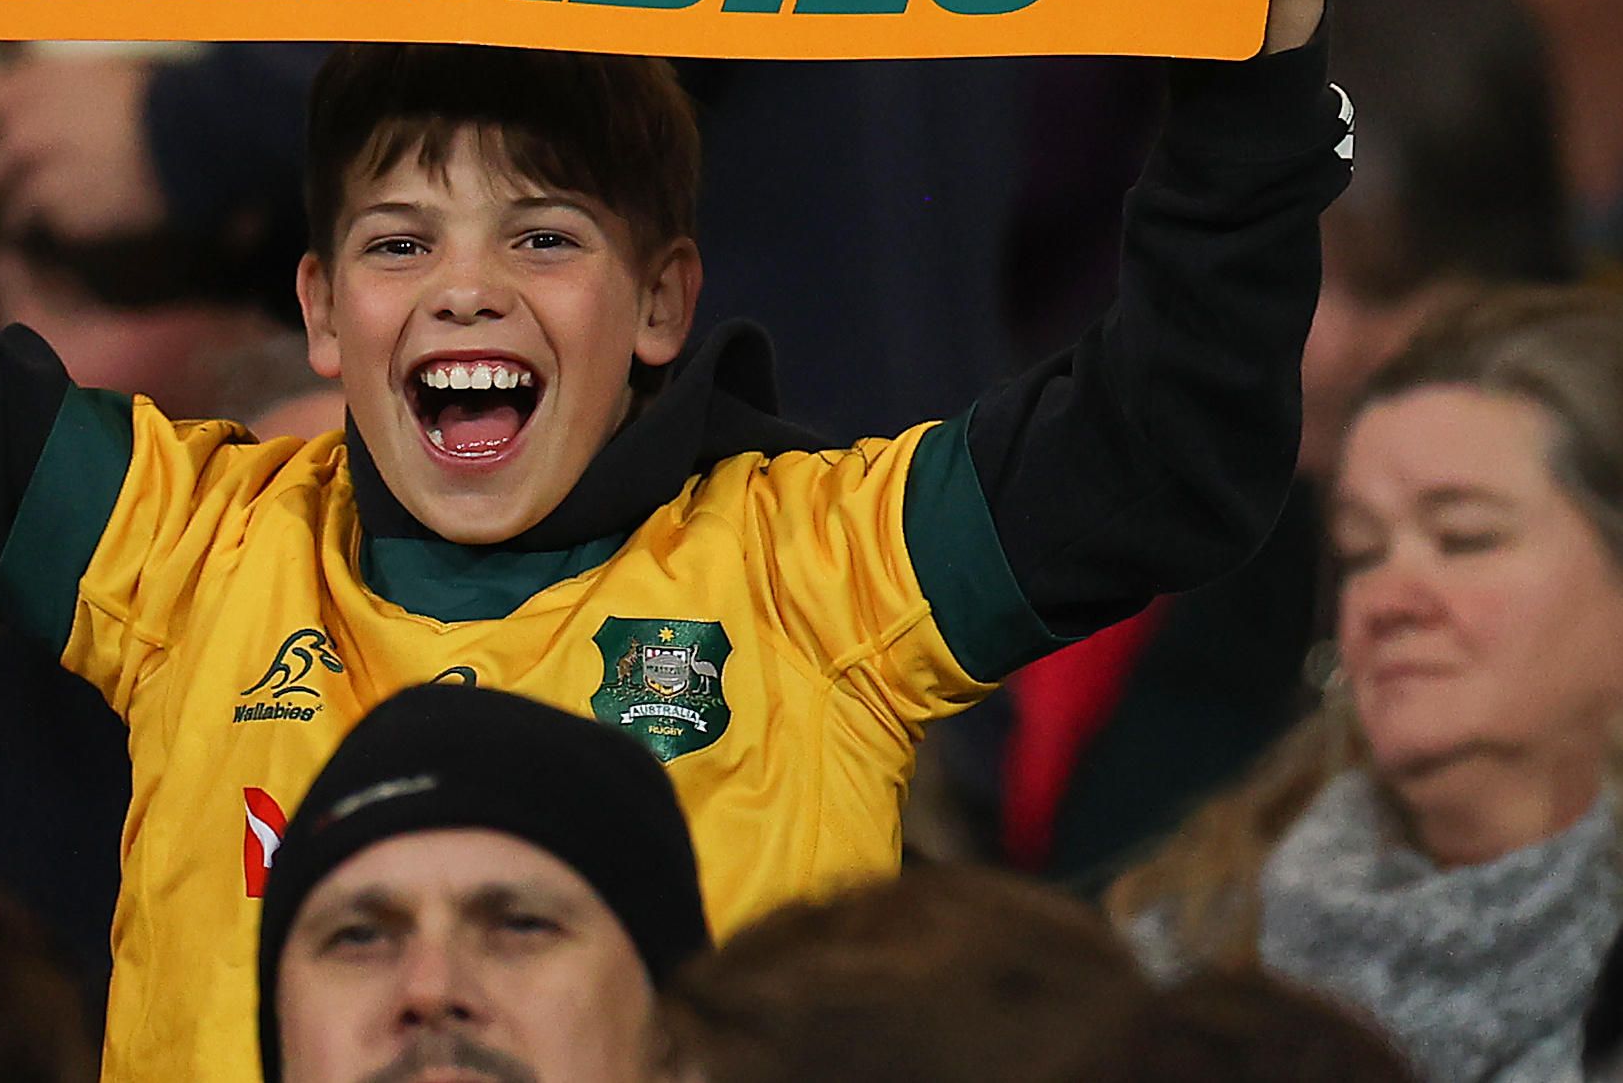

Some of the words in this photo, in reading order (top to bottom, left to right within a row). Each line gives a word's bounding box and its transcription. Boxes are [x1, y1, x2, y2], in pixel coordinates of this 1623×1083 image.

[233, 702, 315, 723] Wallabies
[633, 704, 698, 722] AUSTRALIA
[648, 725, 684, 736] RUGBY
